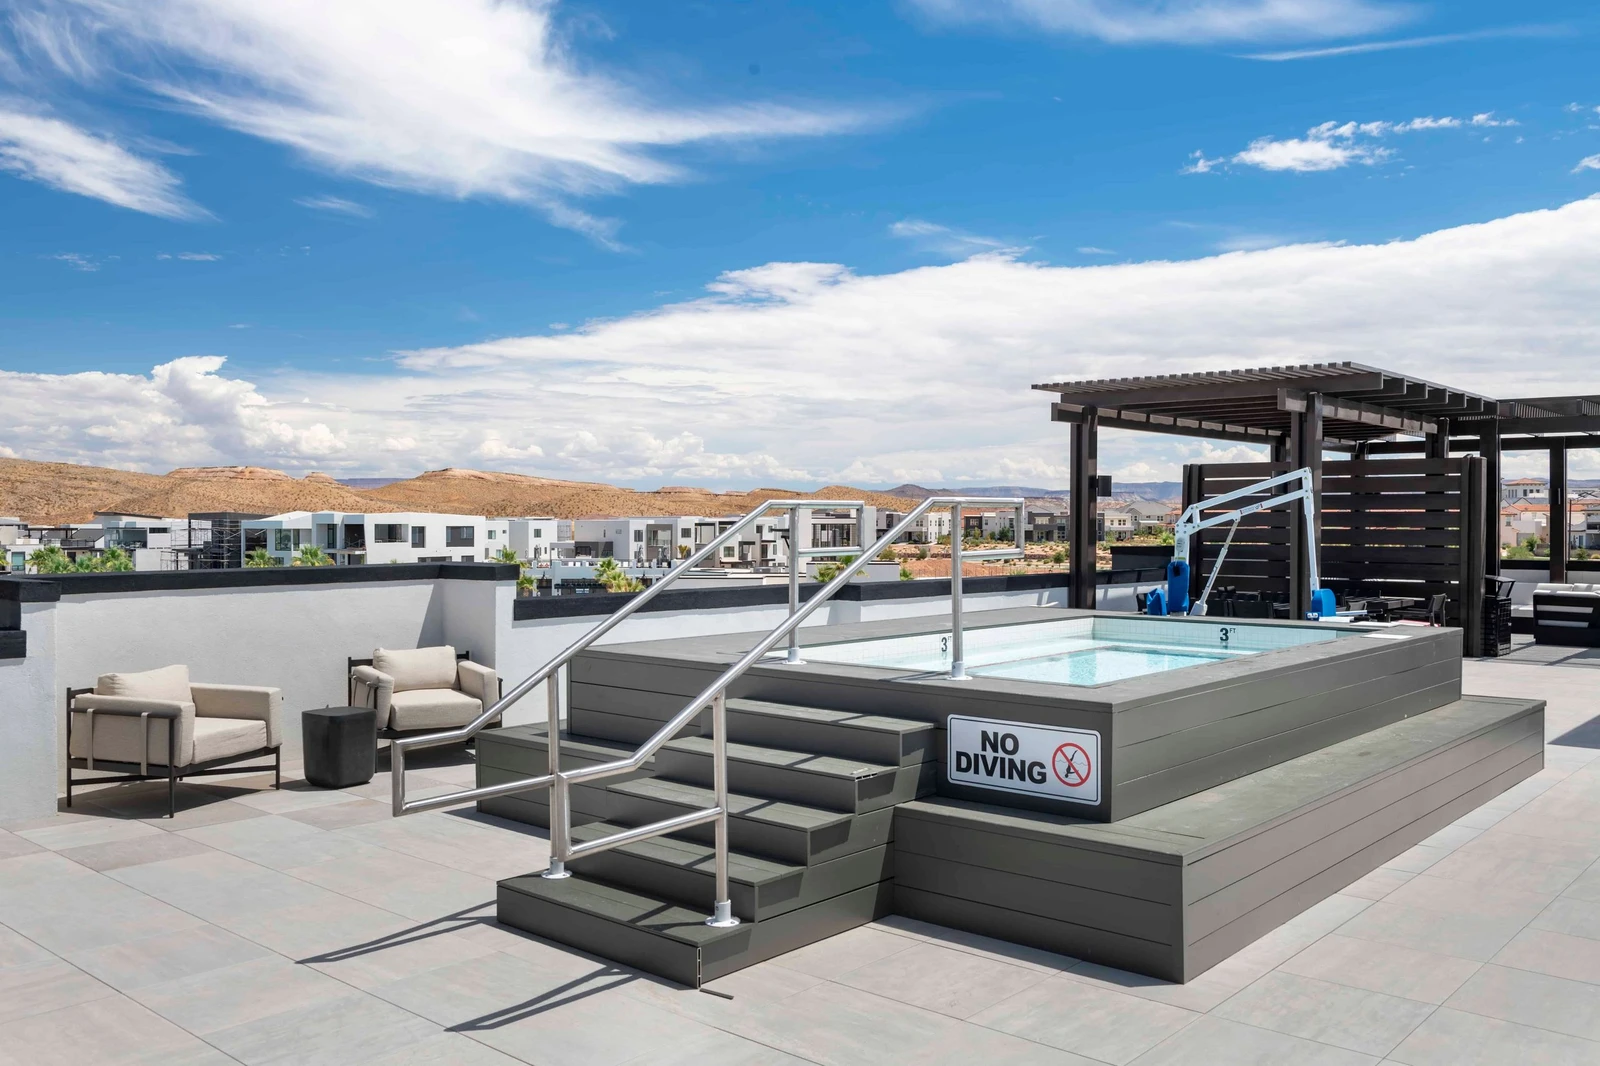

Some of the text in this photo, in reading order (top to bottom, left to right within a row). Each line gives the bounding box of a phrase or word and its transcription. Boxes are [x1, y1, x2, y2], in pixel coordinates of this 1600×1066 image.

[941, 636, 948, 652] 3
[1220, 627, 1229, 641] 3
[981, 730, 1019, 756] NO
[956, 751, 1047, 784] DIVING
